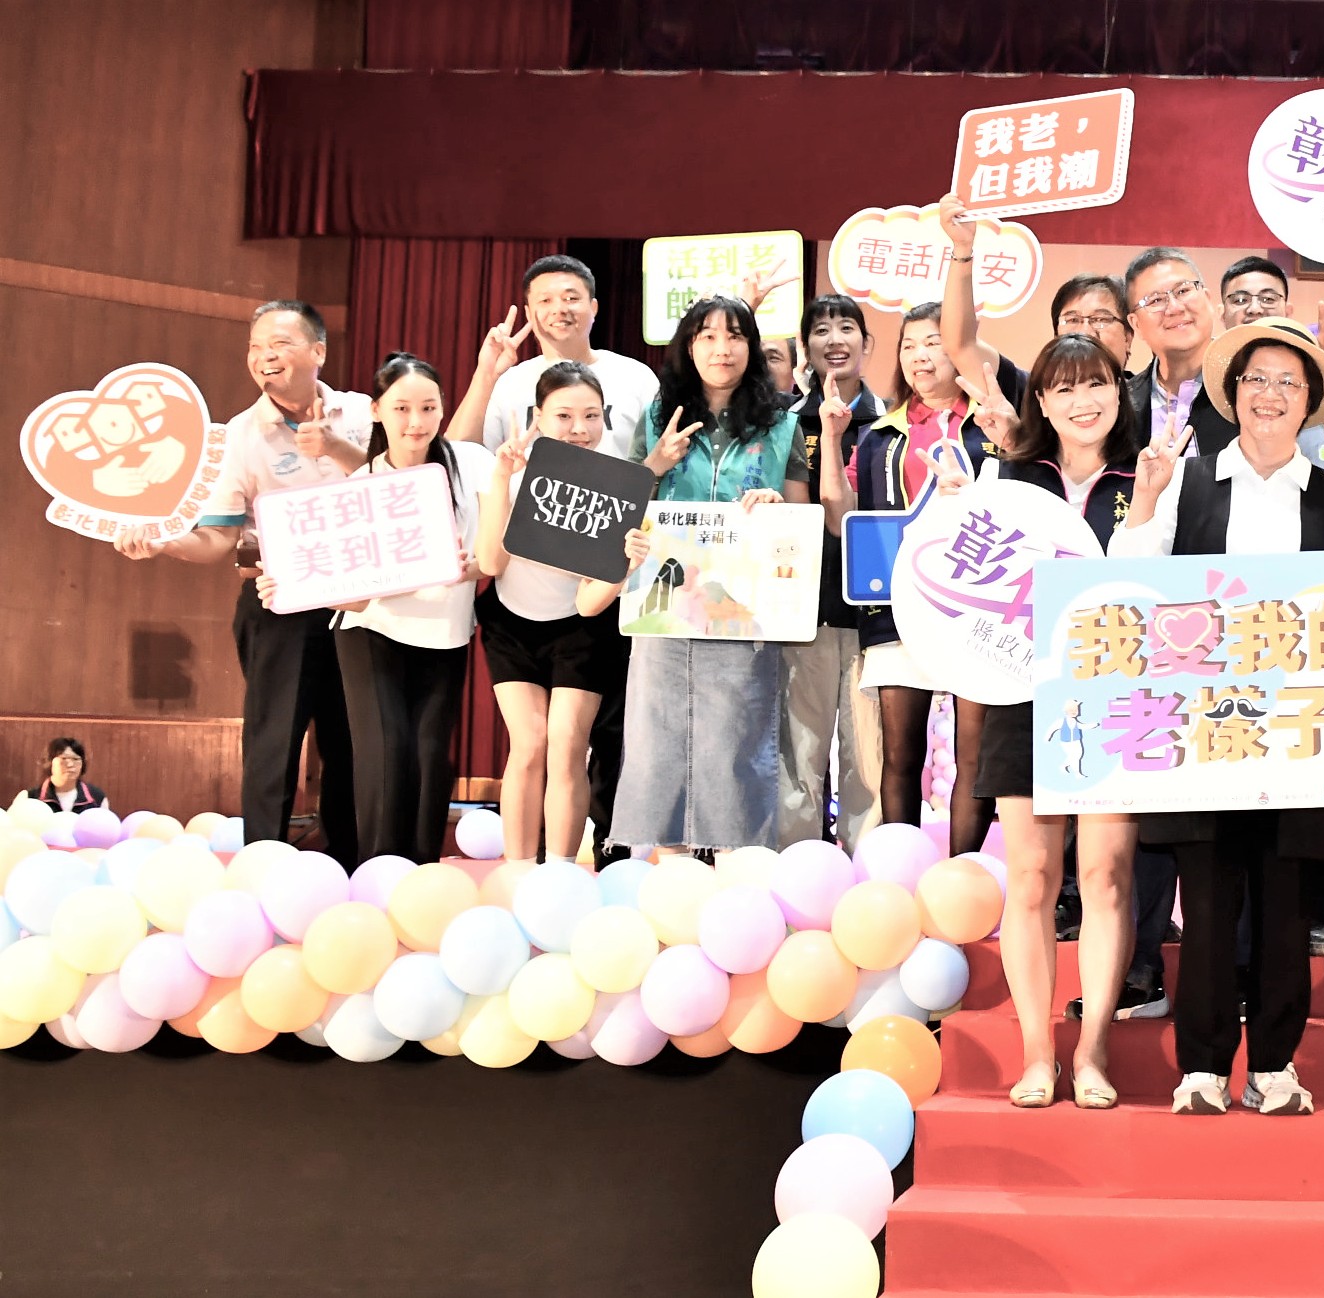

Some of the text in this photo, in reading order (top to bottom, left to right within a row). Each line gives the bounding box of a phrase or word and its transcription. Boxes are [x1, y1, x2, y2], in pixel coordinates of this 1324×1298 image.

[969, 149, 1099, 202] 但我潮
[667, 243, 778, 281] 活到老
[285, 481, 420, 535] 活到老
[530, 476, 630, 523] QUEEN
[533, 500, 610, 539] SHOP
[658, 511, 725, 527] 彰化縣長青
[292, 525, 427, 582] 美到老
[697, 530, 739, 544] 幸福卡
